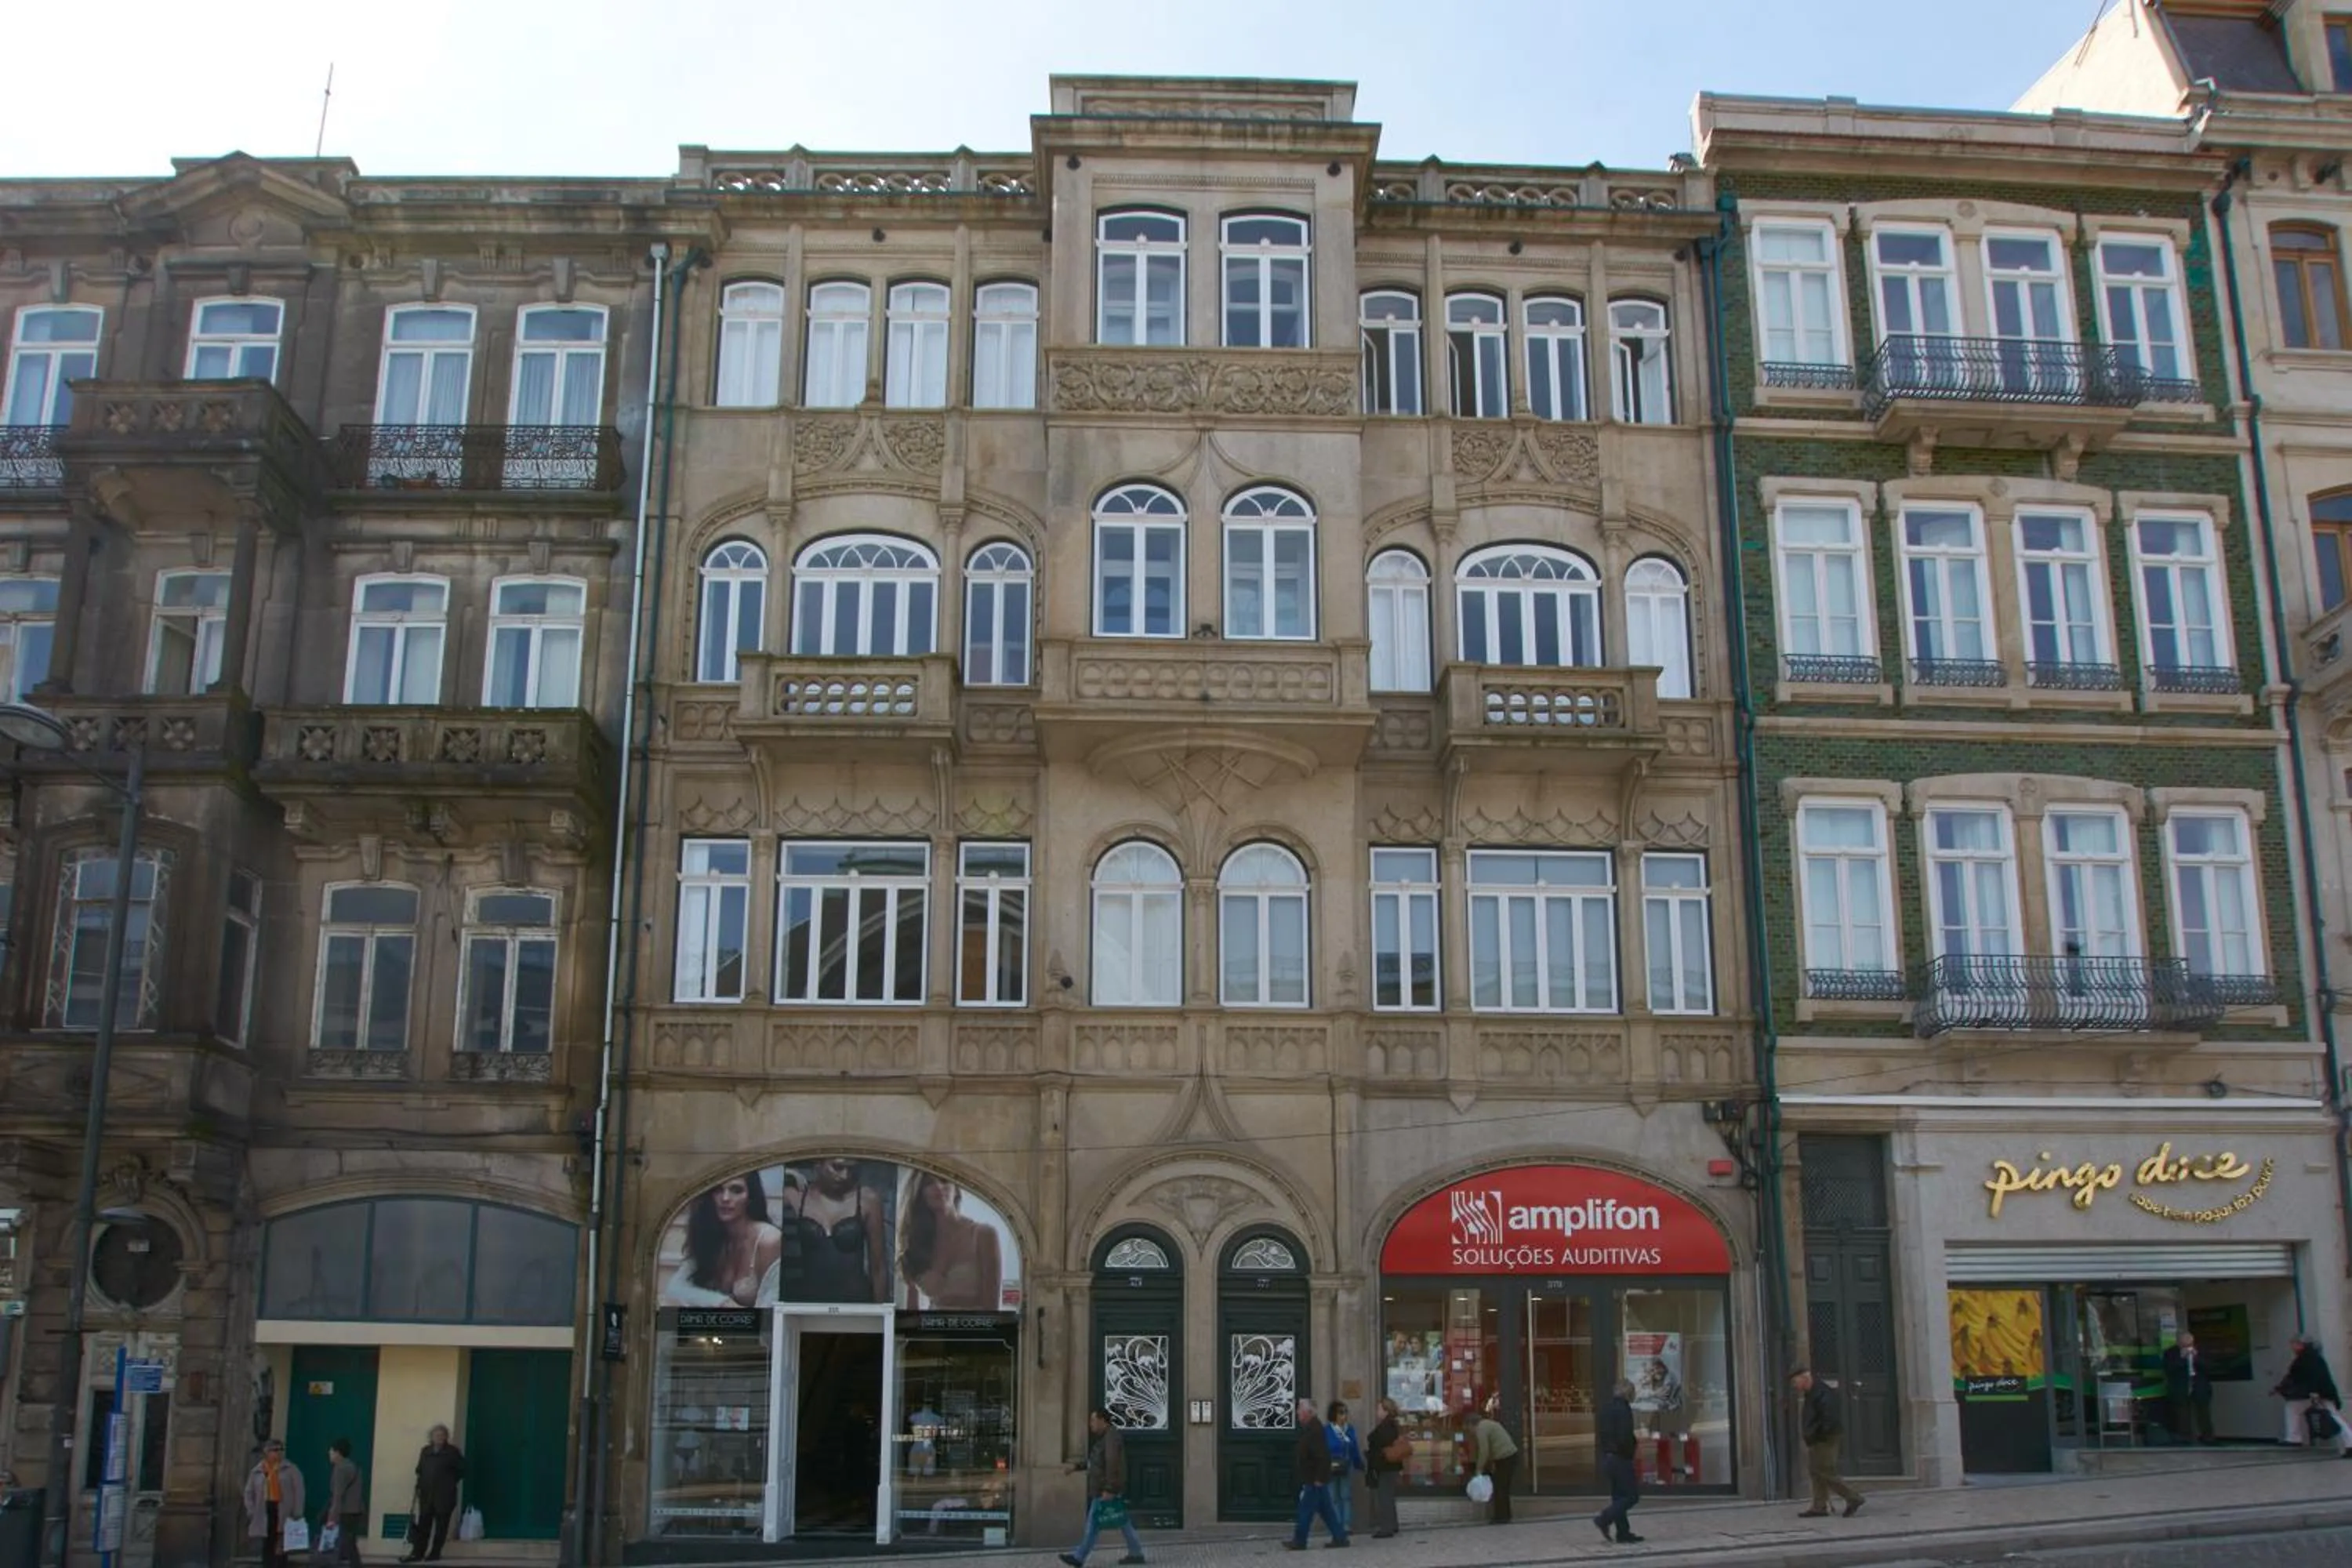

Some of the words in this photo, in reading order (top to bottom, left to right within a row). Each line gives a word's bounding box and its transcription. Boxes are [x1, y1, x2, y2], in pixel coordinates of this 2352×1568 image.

[1984, 1151, 2122, 1218] pingo
[2136, 1141, 2251, 1185] doce
[1508, 1198, 1661, 1238] amplifon
[1452, 1243, 1555, 1269] SOLUÇÕES
[1560, 1247, 1662, 1265] AUDITIVAS
